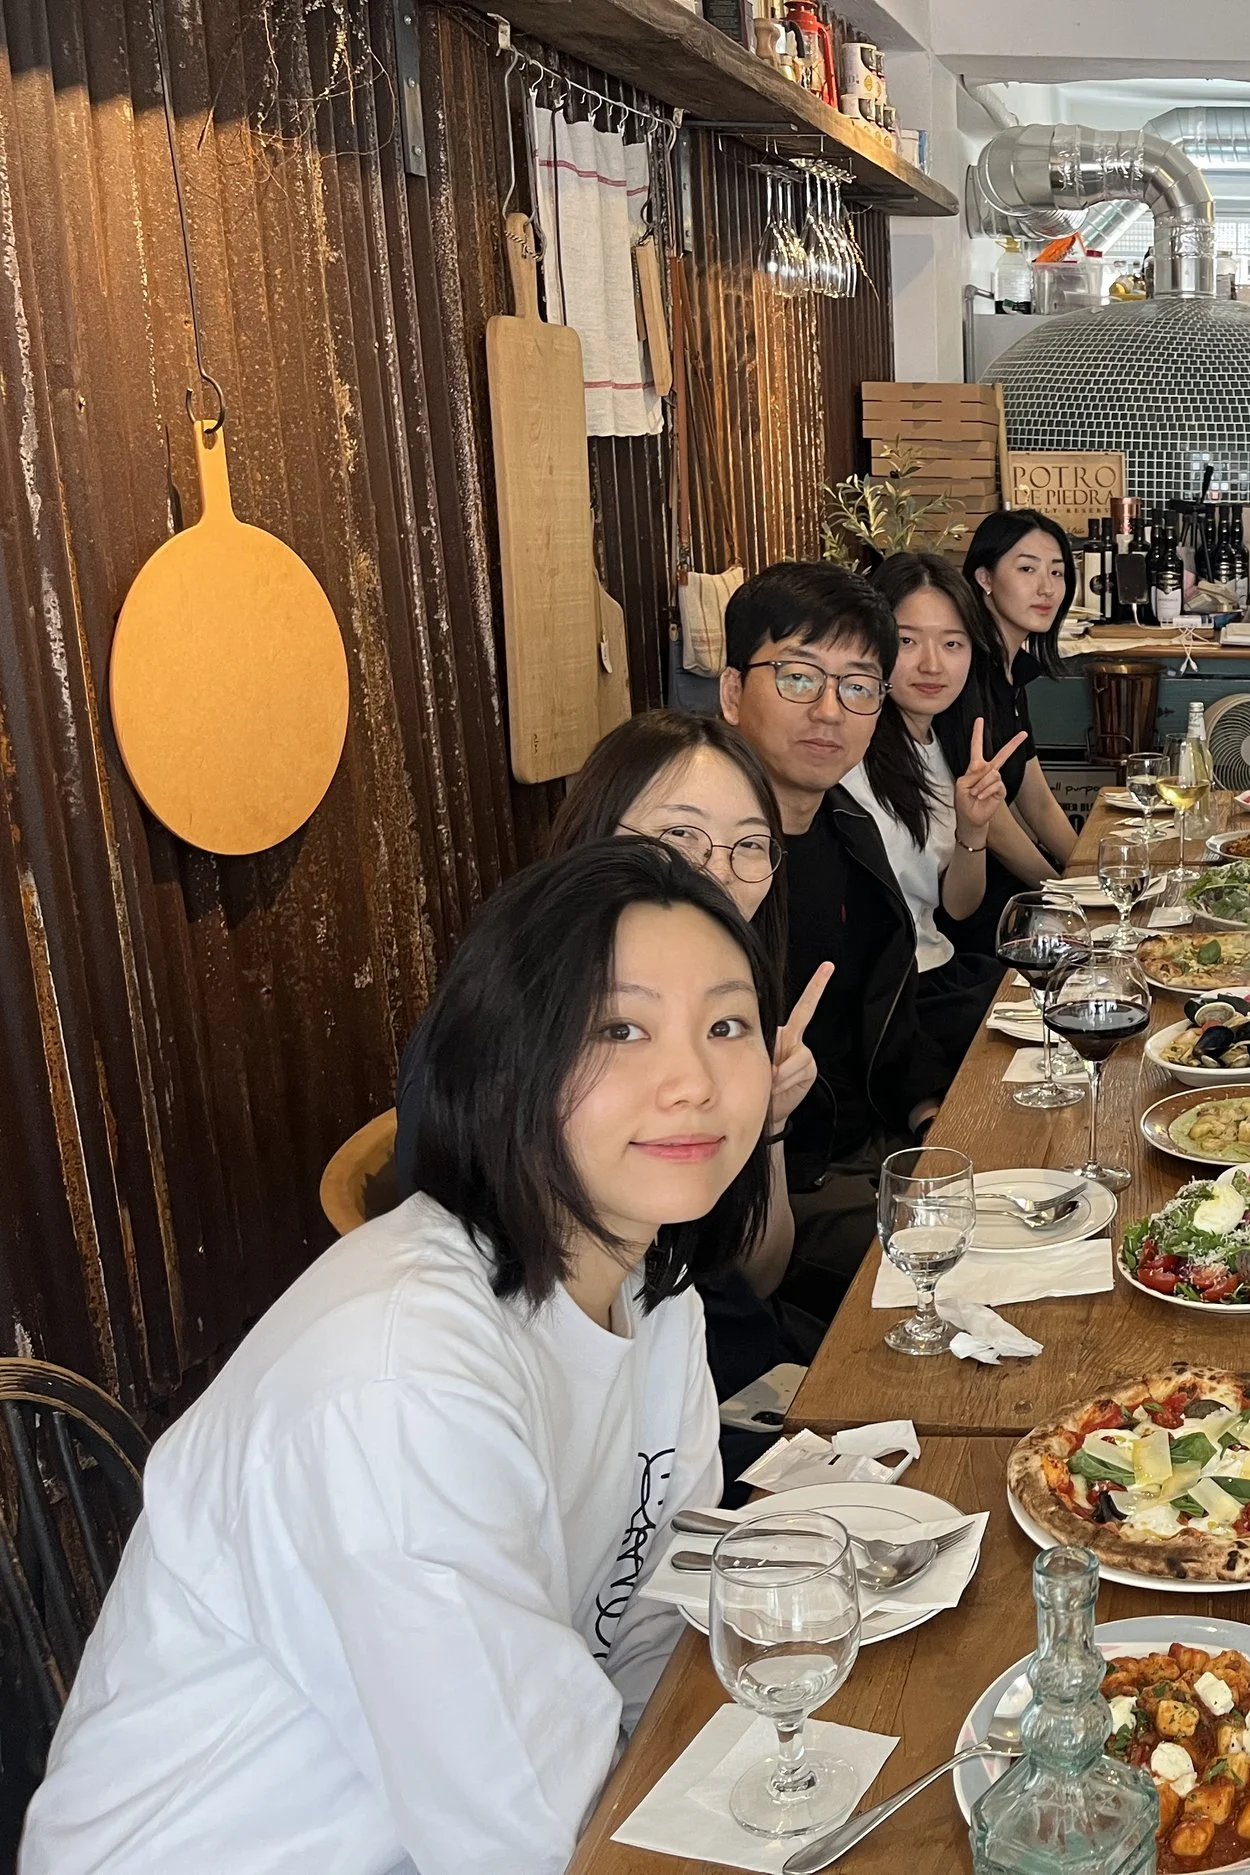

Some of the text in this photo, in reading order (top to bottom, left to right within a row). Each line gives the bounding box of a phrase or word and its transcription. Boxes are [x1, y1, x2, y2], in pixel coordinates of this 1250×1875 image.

[1013, 466, 1116, 488] POTRO
[1014, 489, 1113, 505] DE PIEDRA
